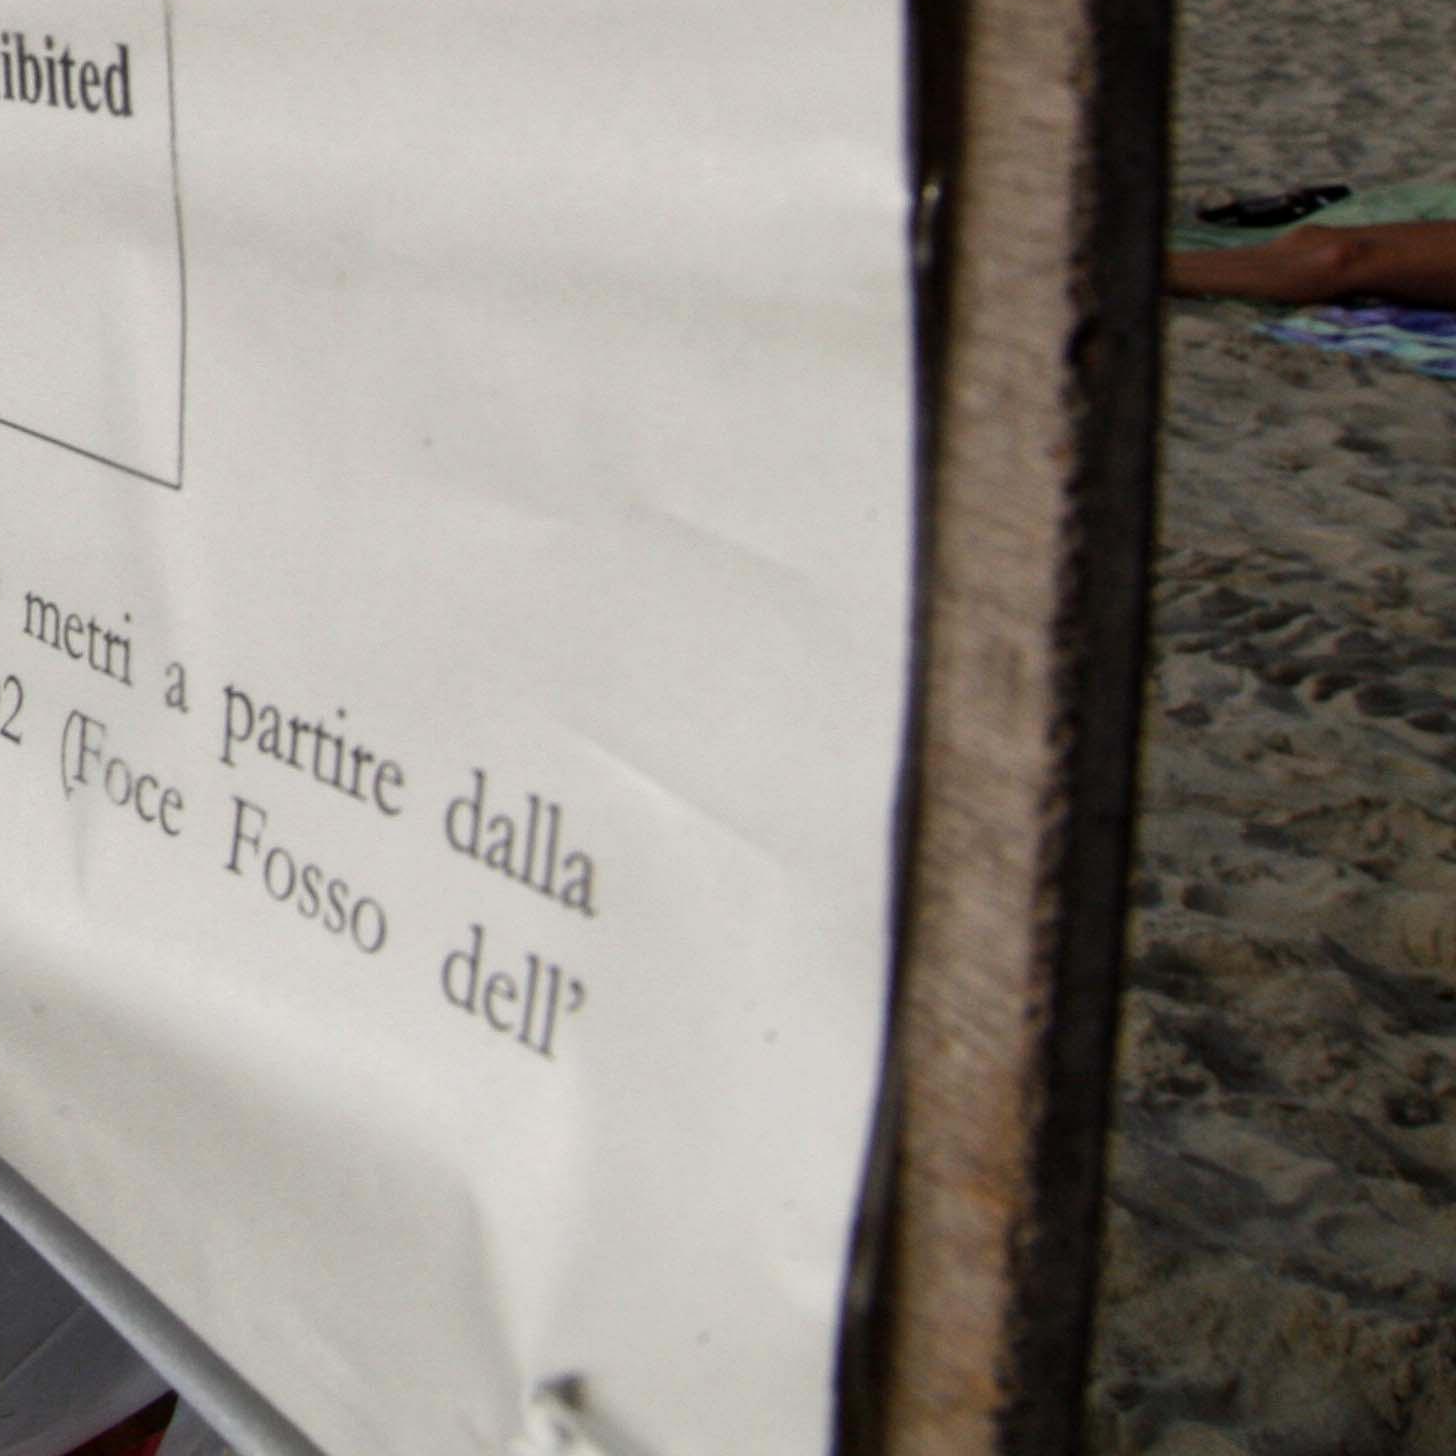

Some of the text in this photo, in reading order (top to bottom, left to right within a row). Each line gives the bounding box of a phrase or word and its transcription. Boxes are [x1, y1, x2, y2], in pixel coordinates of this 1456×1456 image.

[23, 591, 133, 687] metri
[164, 661, 189, 714] a
[220, 683, 404, 817] partire
[443, 767, 598, 919] dalla
[61, 709, 184, 836] (Foce
[223, 795, 387, 955] Fosso
